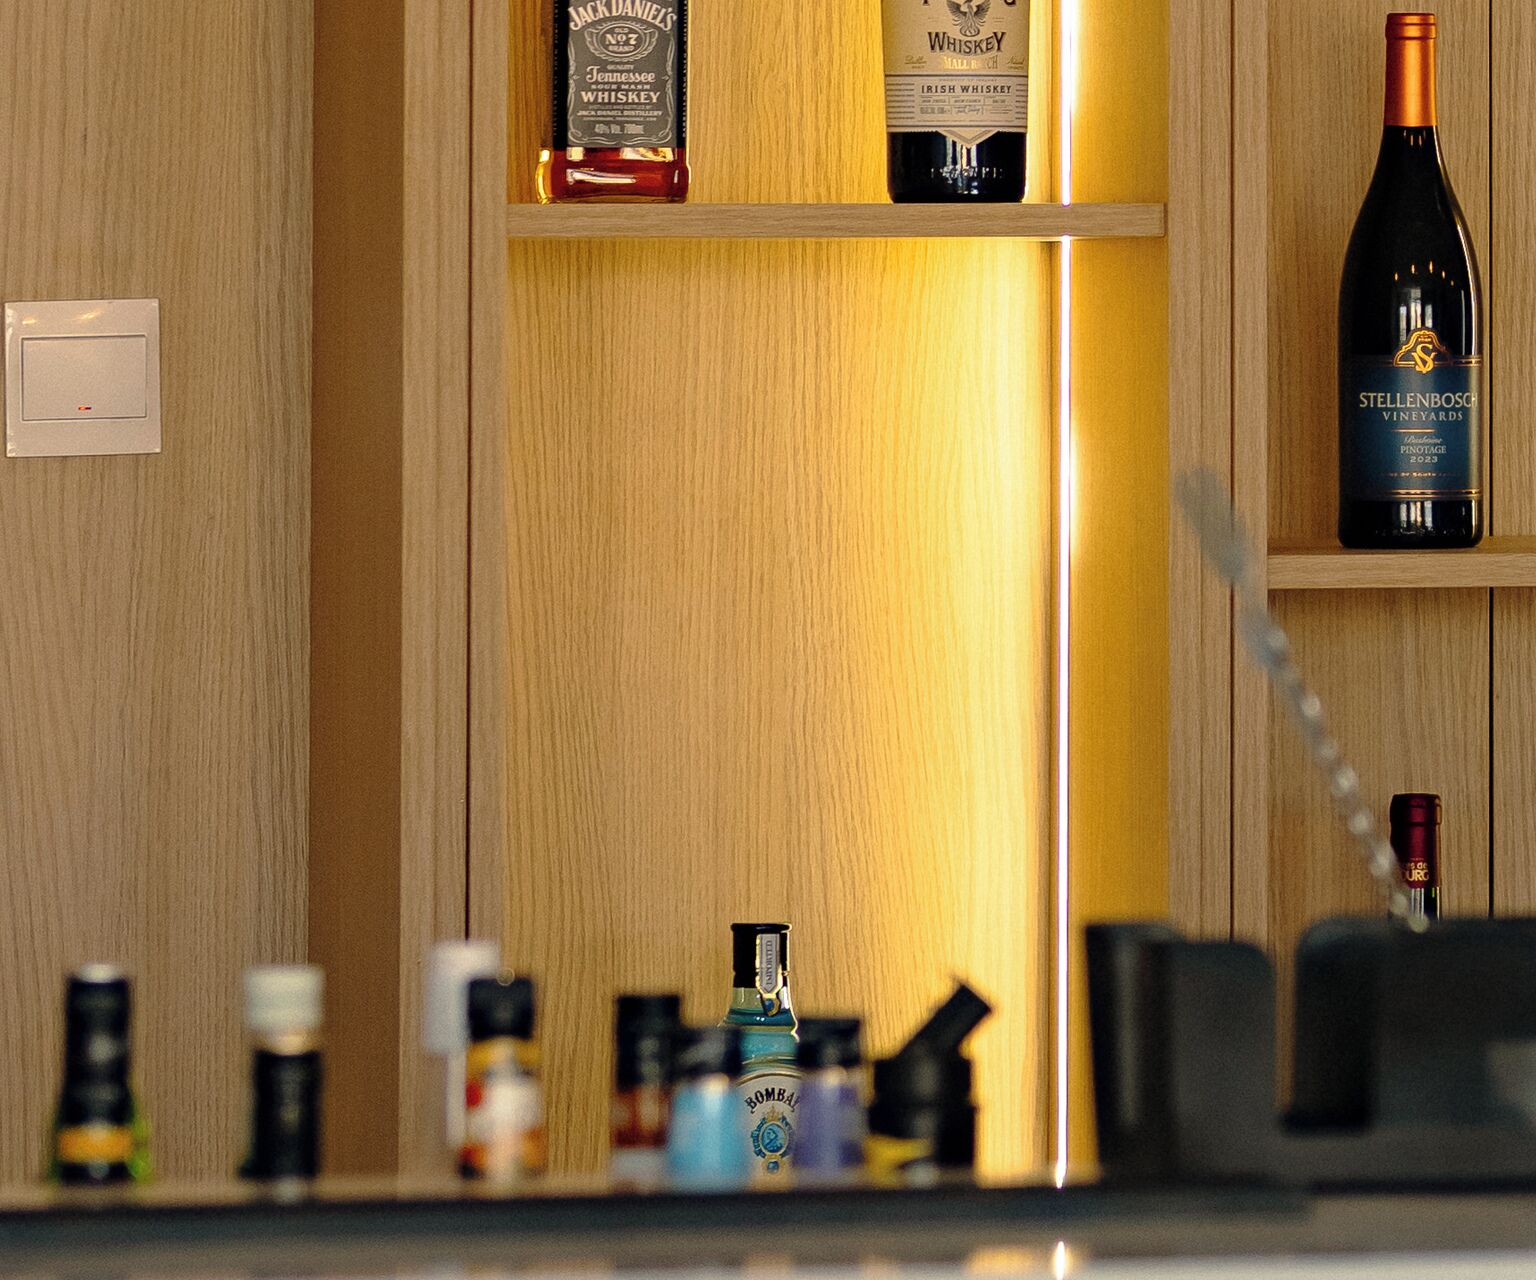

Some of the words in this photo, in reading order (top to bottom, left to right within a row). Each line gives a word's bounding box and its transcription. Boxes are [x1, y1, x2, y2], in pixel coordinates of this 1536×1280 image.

[928, 31, 1007, 56] WHISKEY
[585, 65, 657, 84] Tennessee
[921, 84, 957, 94] IRISH
[960, 84, 1013, 95] WHISKEY
[580, 90, 661, 105] WHISKEY
[1359, 392, 1479, 409] STELLENBOSCH
[1382, 411, 1464, 422] VINEYARDS
[1400, 445, 1448, 455] PINOTAGE
[1409, 456, 1439, 464] 2023
[766, 939, 774, 986] IMPORTED
